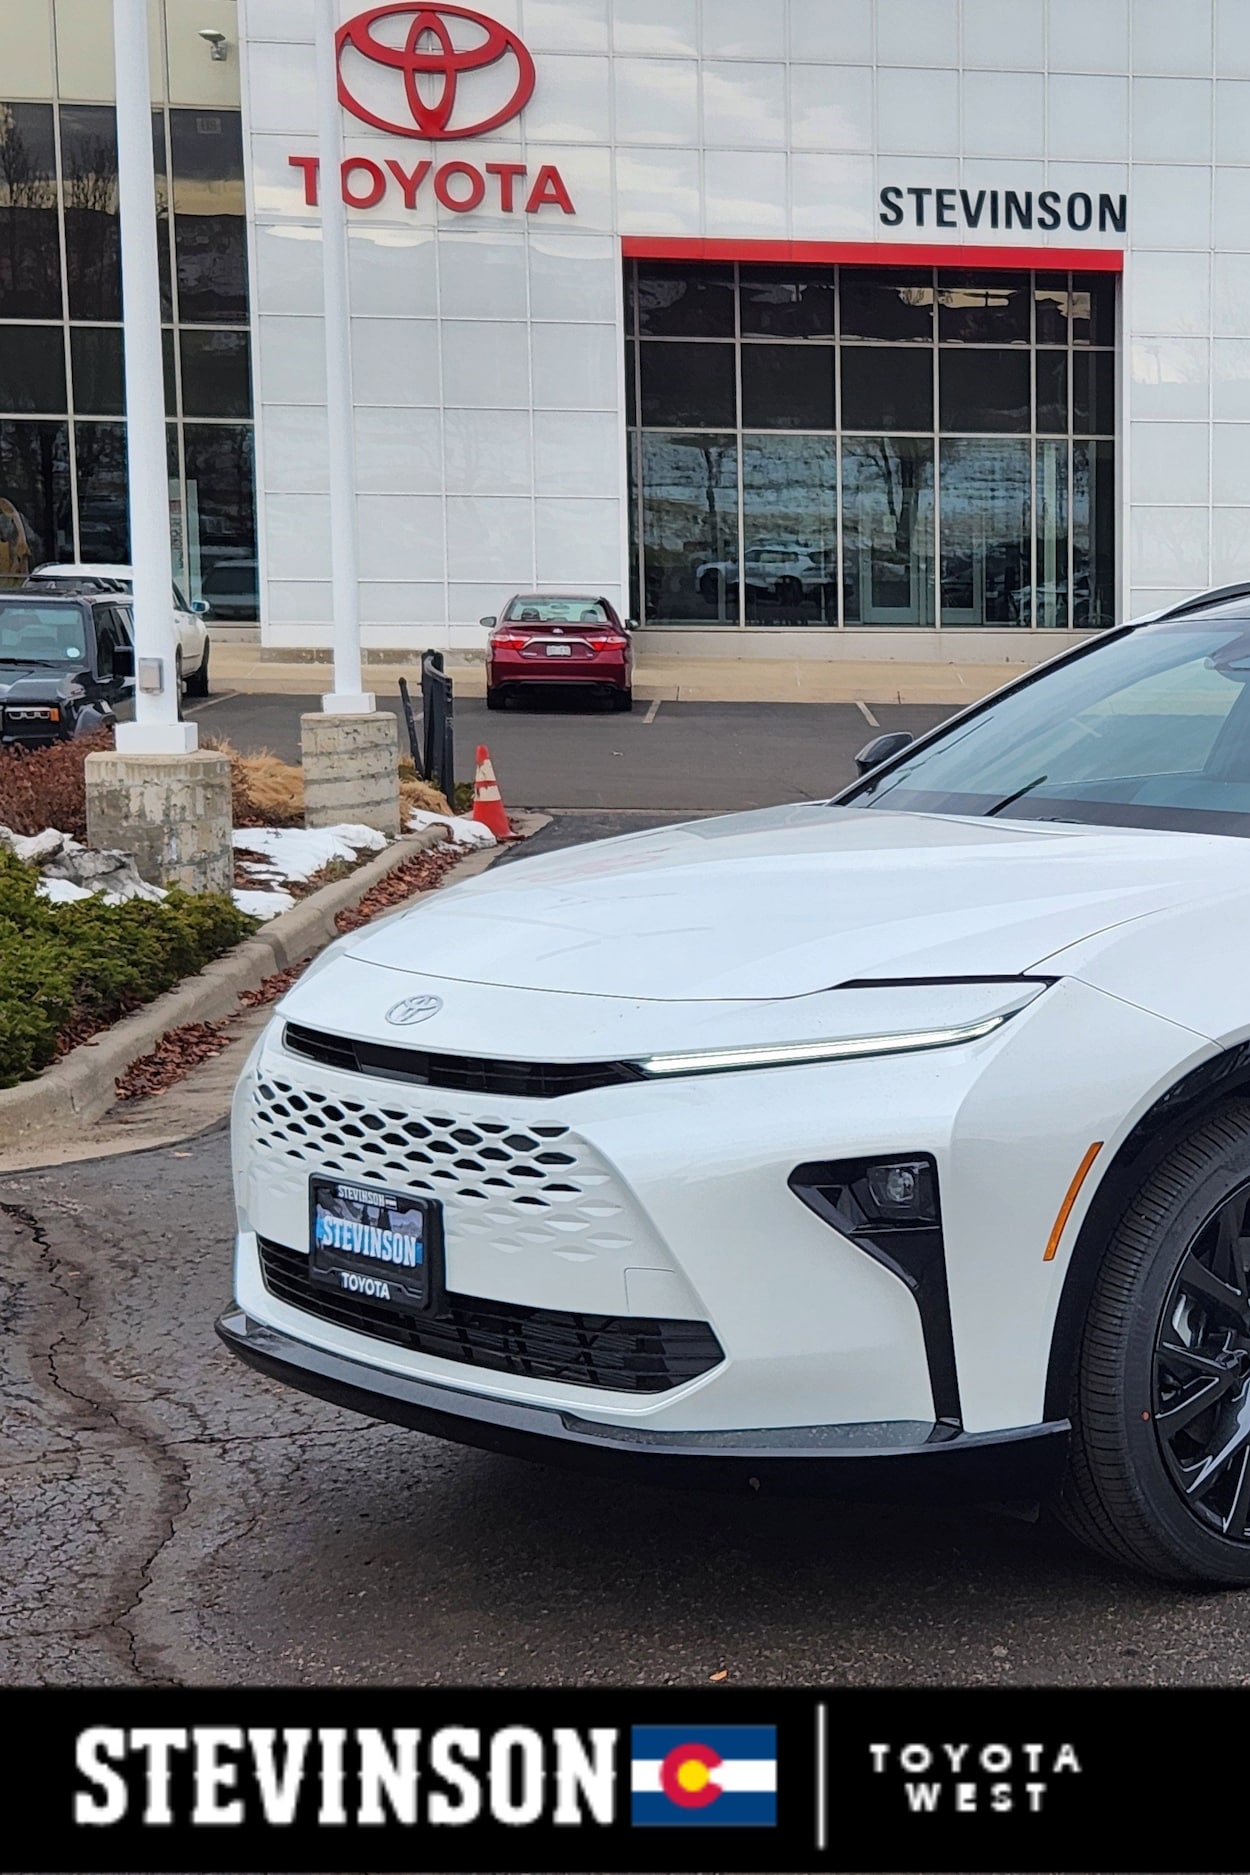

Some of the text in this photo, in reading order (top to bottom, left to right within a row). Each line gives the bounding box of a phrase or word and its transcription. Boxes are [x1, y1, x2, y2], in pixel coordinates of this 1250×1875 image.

[288, 155, 576, 214] TOYOTA
[879, 186, 1127, 233] STEVINSON
[337, 1184, 385, 1207] STEVINSON
[321, 1215, 417, 1267] STEVINSON
[341, 1272, 391, 1300] TOYOTA
